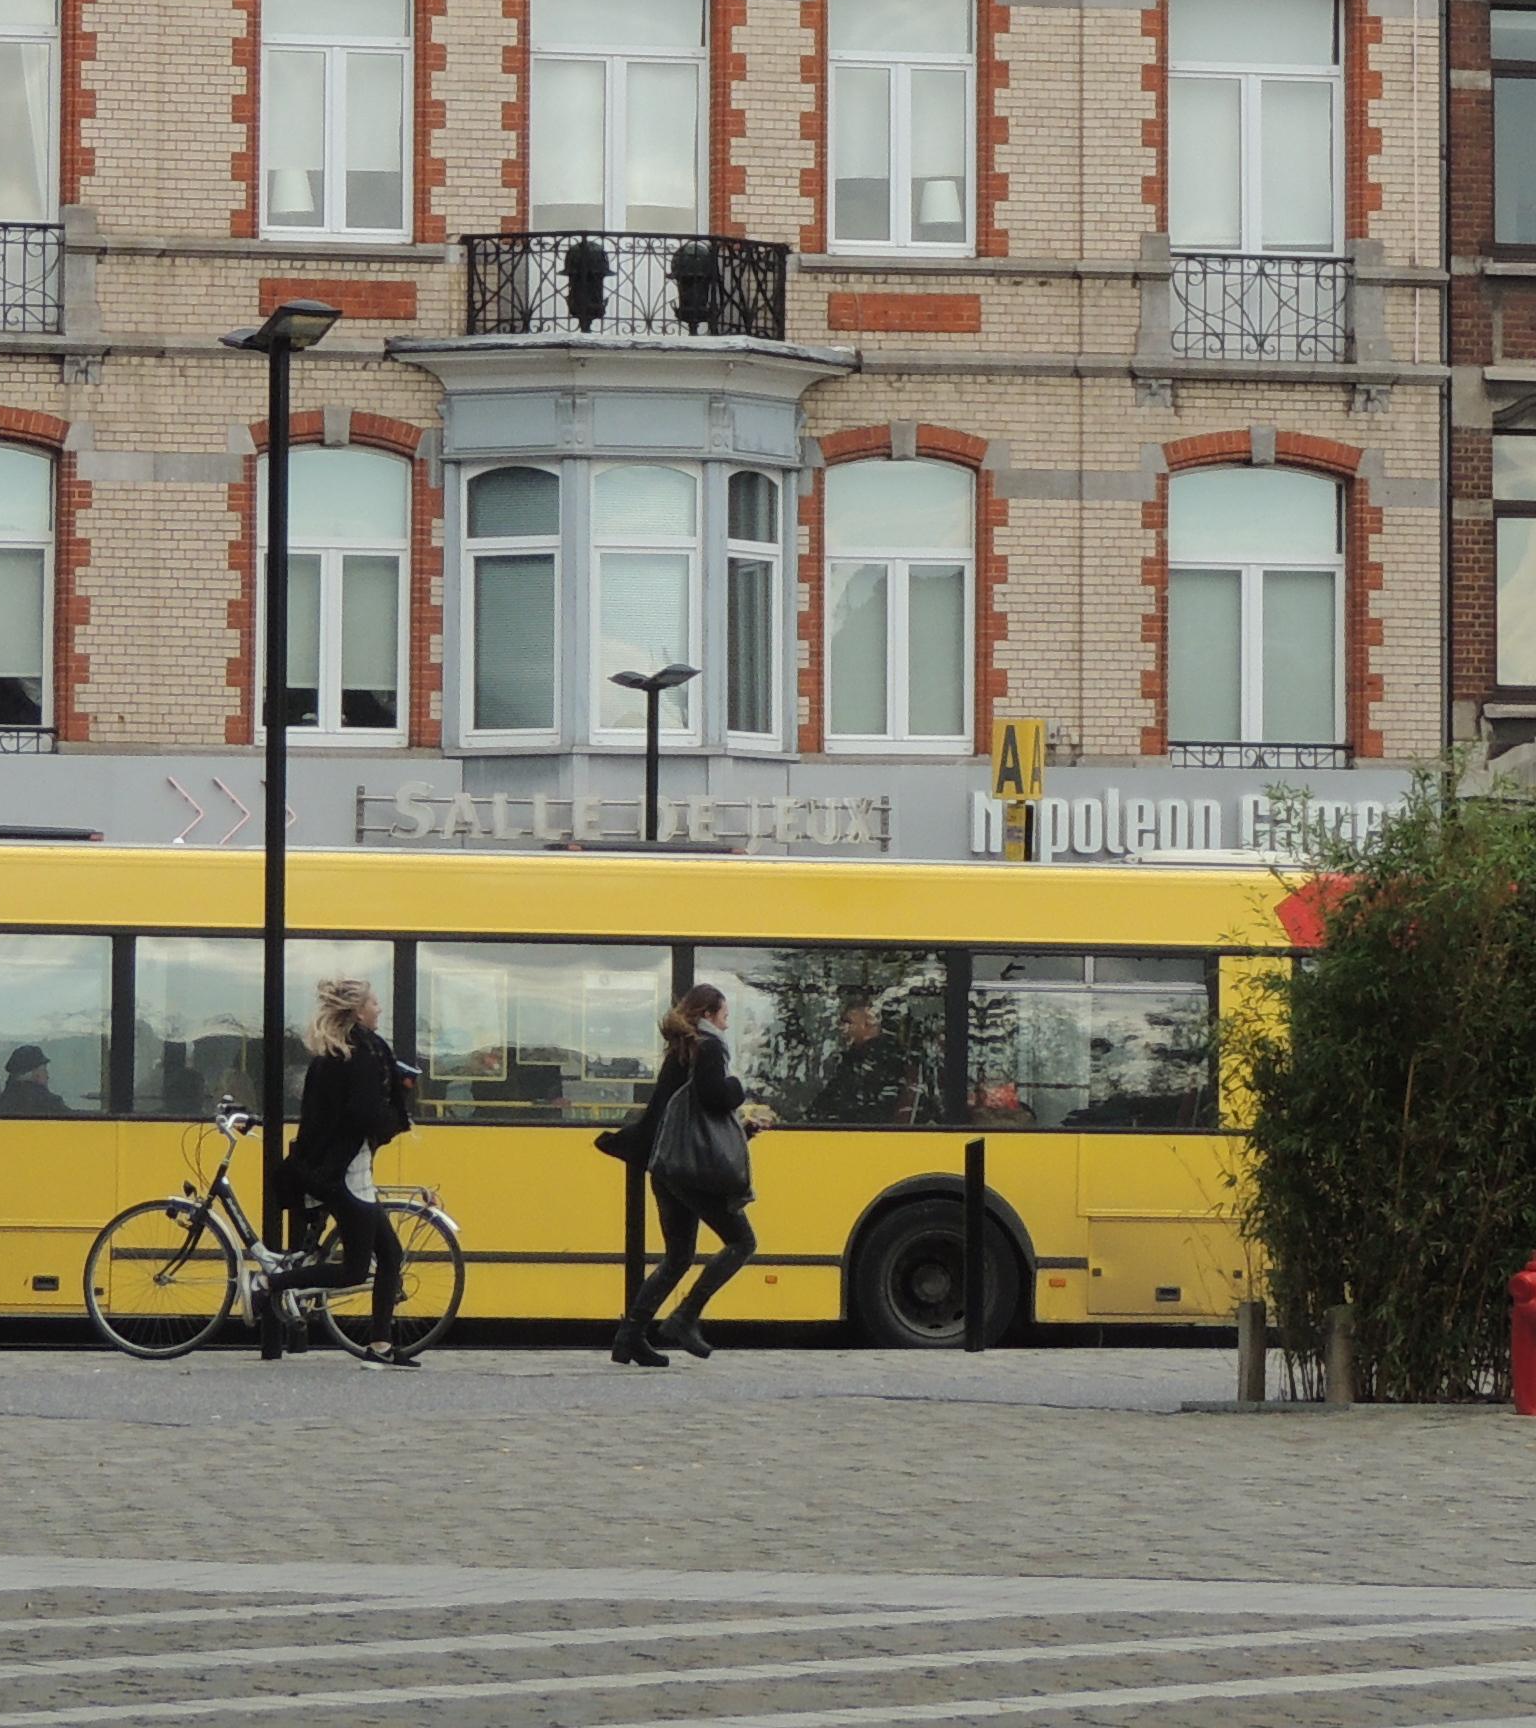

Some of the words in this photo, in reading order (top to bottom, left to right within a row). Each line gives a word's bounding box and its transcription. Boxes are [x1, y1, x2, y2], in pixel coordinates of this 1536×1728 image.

[996, 724, 1024, 794] A
[390, 780, 602, 841] SALLE
[744, 796, 878, 855] JEUX
